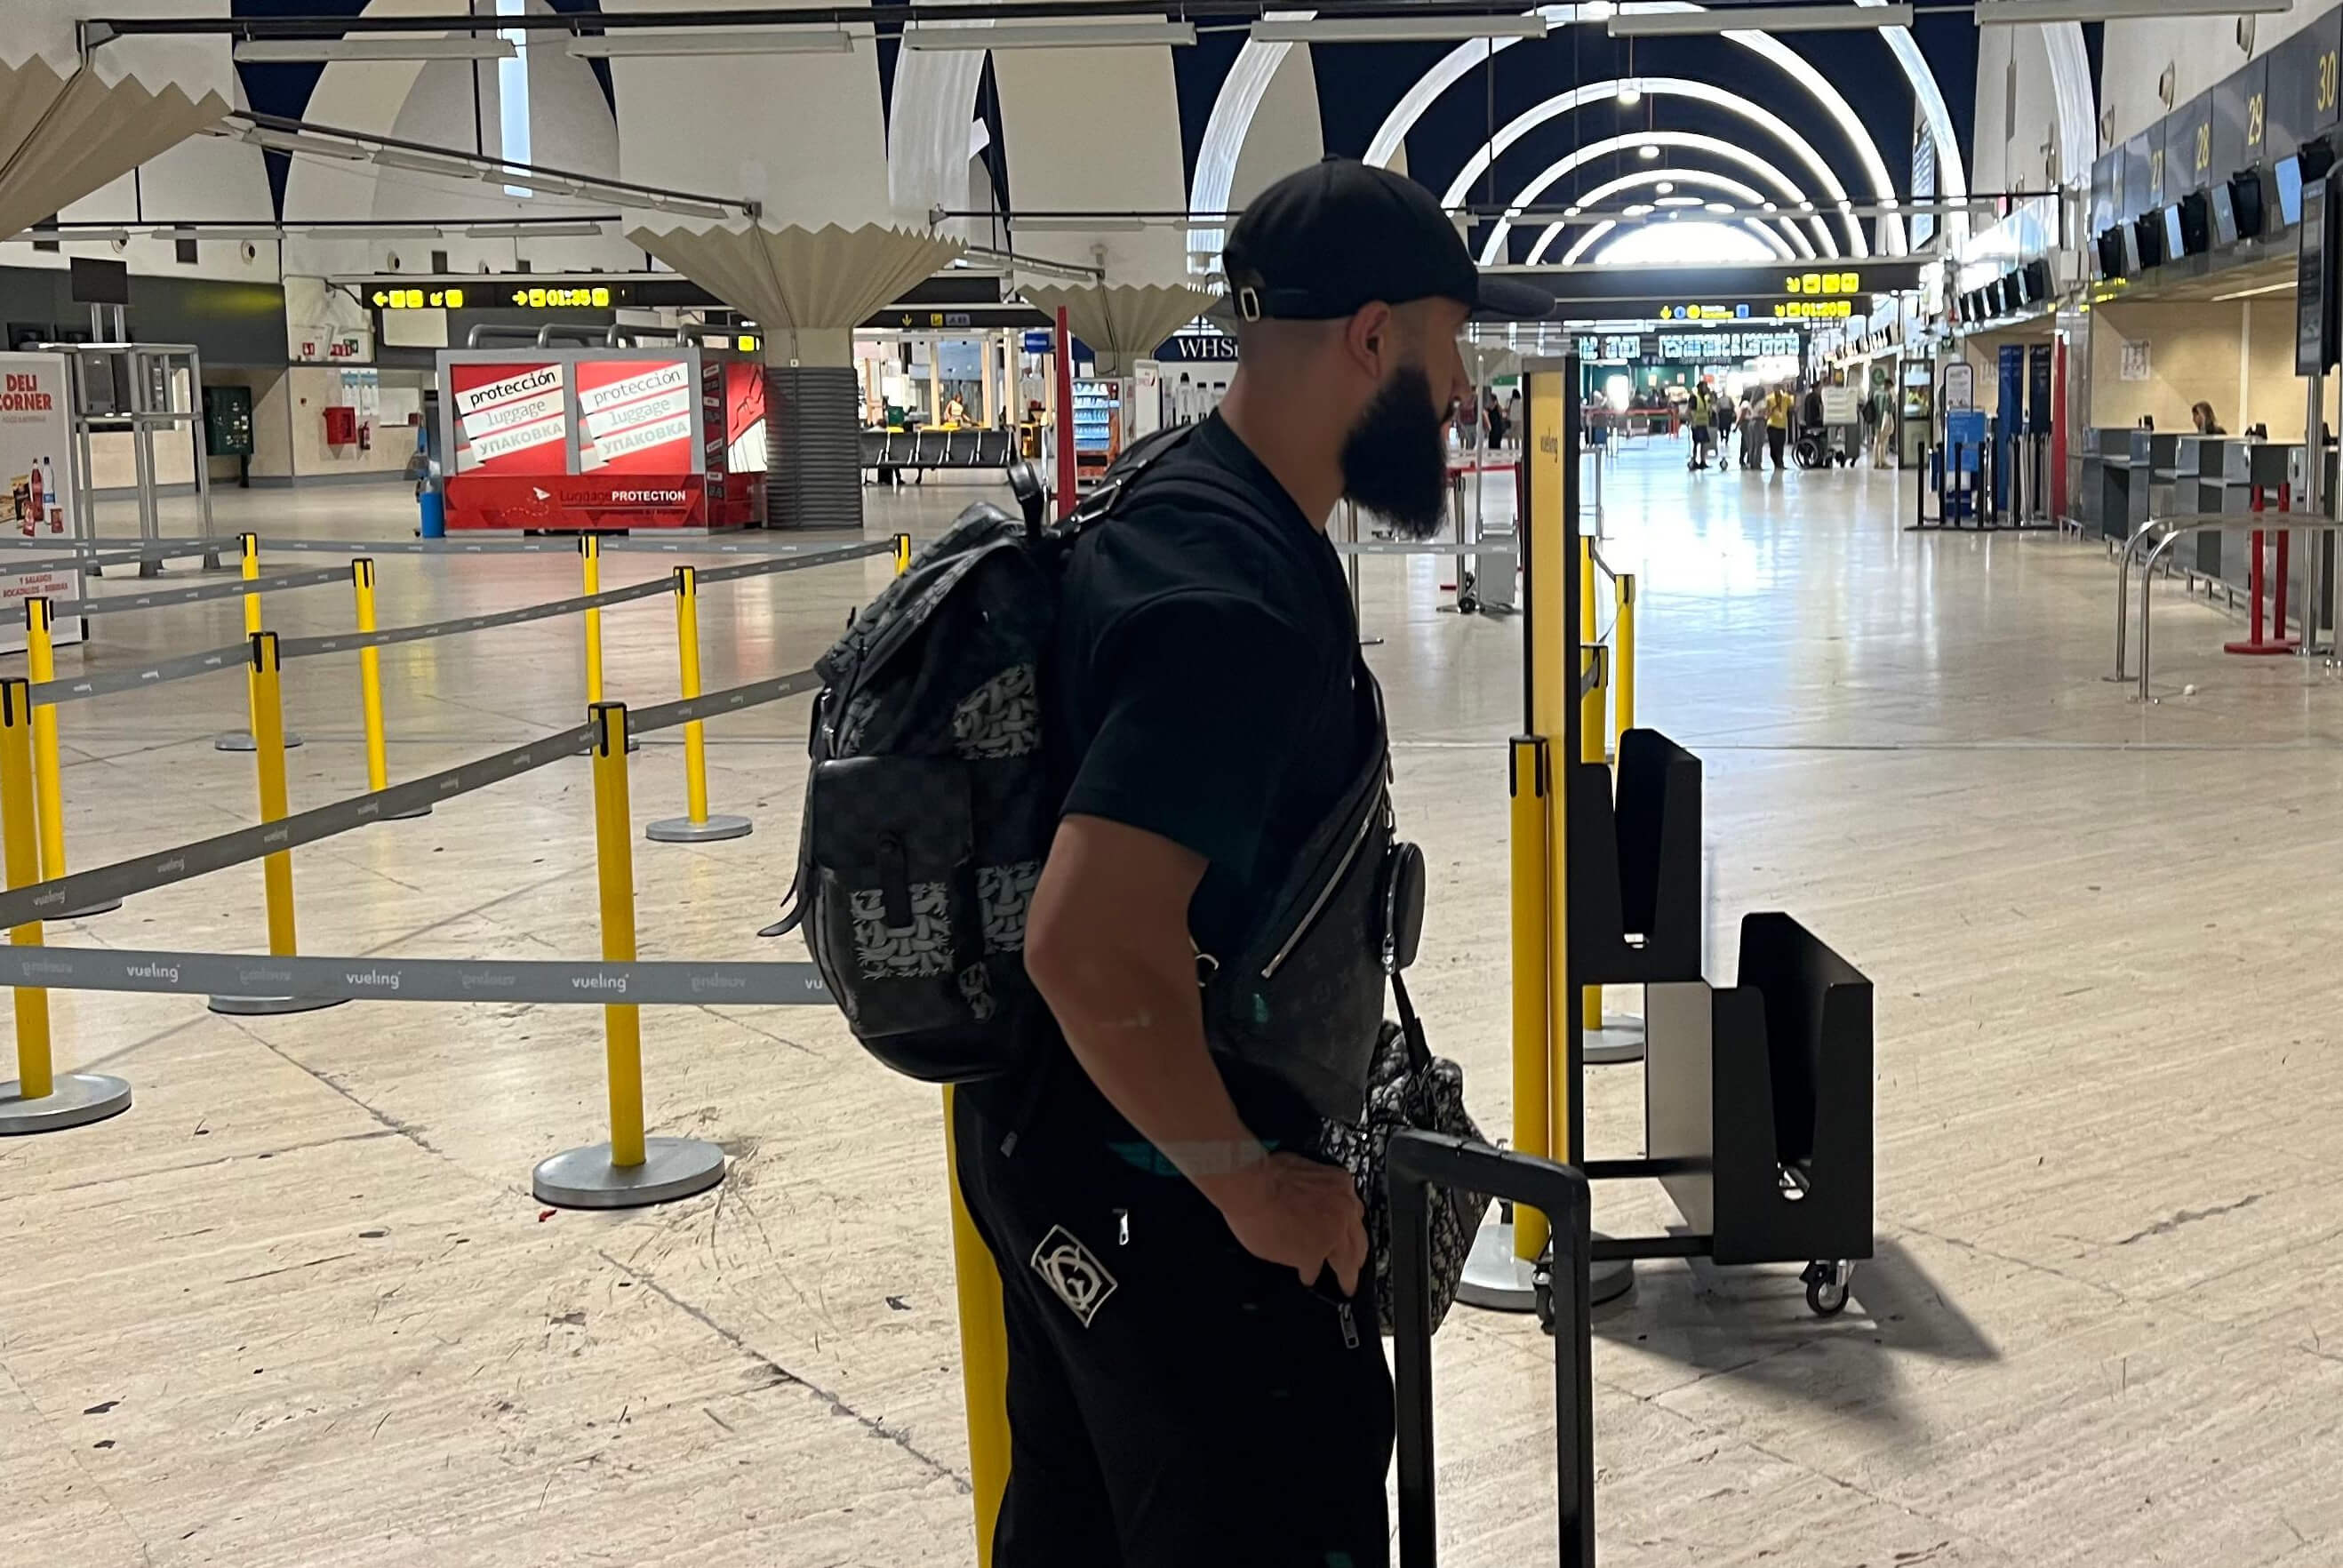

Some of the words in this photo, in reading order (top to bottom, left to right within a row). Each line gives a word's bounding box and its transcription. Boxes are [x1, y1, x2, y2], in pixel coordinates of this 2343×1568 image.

[2317, 50, 2337, 112] 30
[2248, 92, 2263, 146] 29
[2196, 123, 2210, 172] 28
[1178, 338, 1238, 358] WHS
[6, 373, 37, 392] DELI
[470, 369, 556, 408] protección
[594, 368, 681, 407] protección
[486, 400, 546, 427] luggage
[611, 398, 671, 428] luggage
[479, 422, 563, 456] УПАКОВКА
[602, 420, 688, 454] УПАКОВКА
[126, 962, 180, 983] vueling
[346, 968, 402, 989] vueling
[572, 972, 630, 993] vueling
